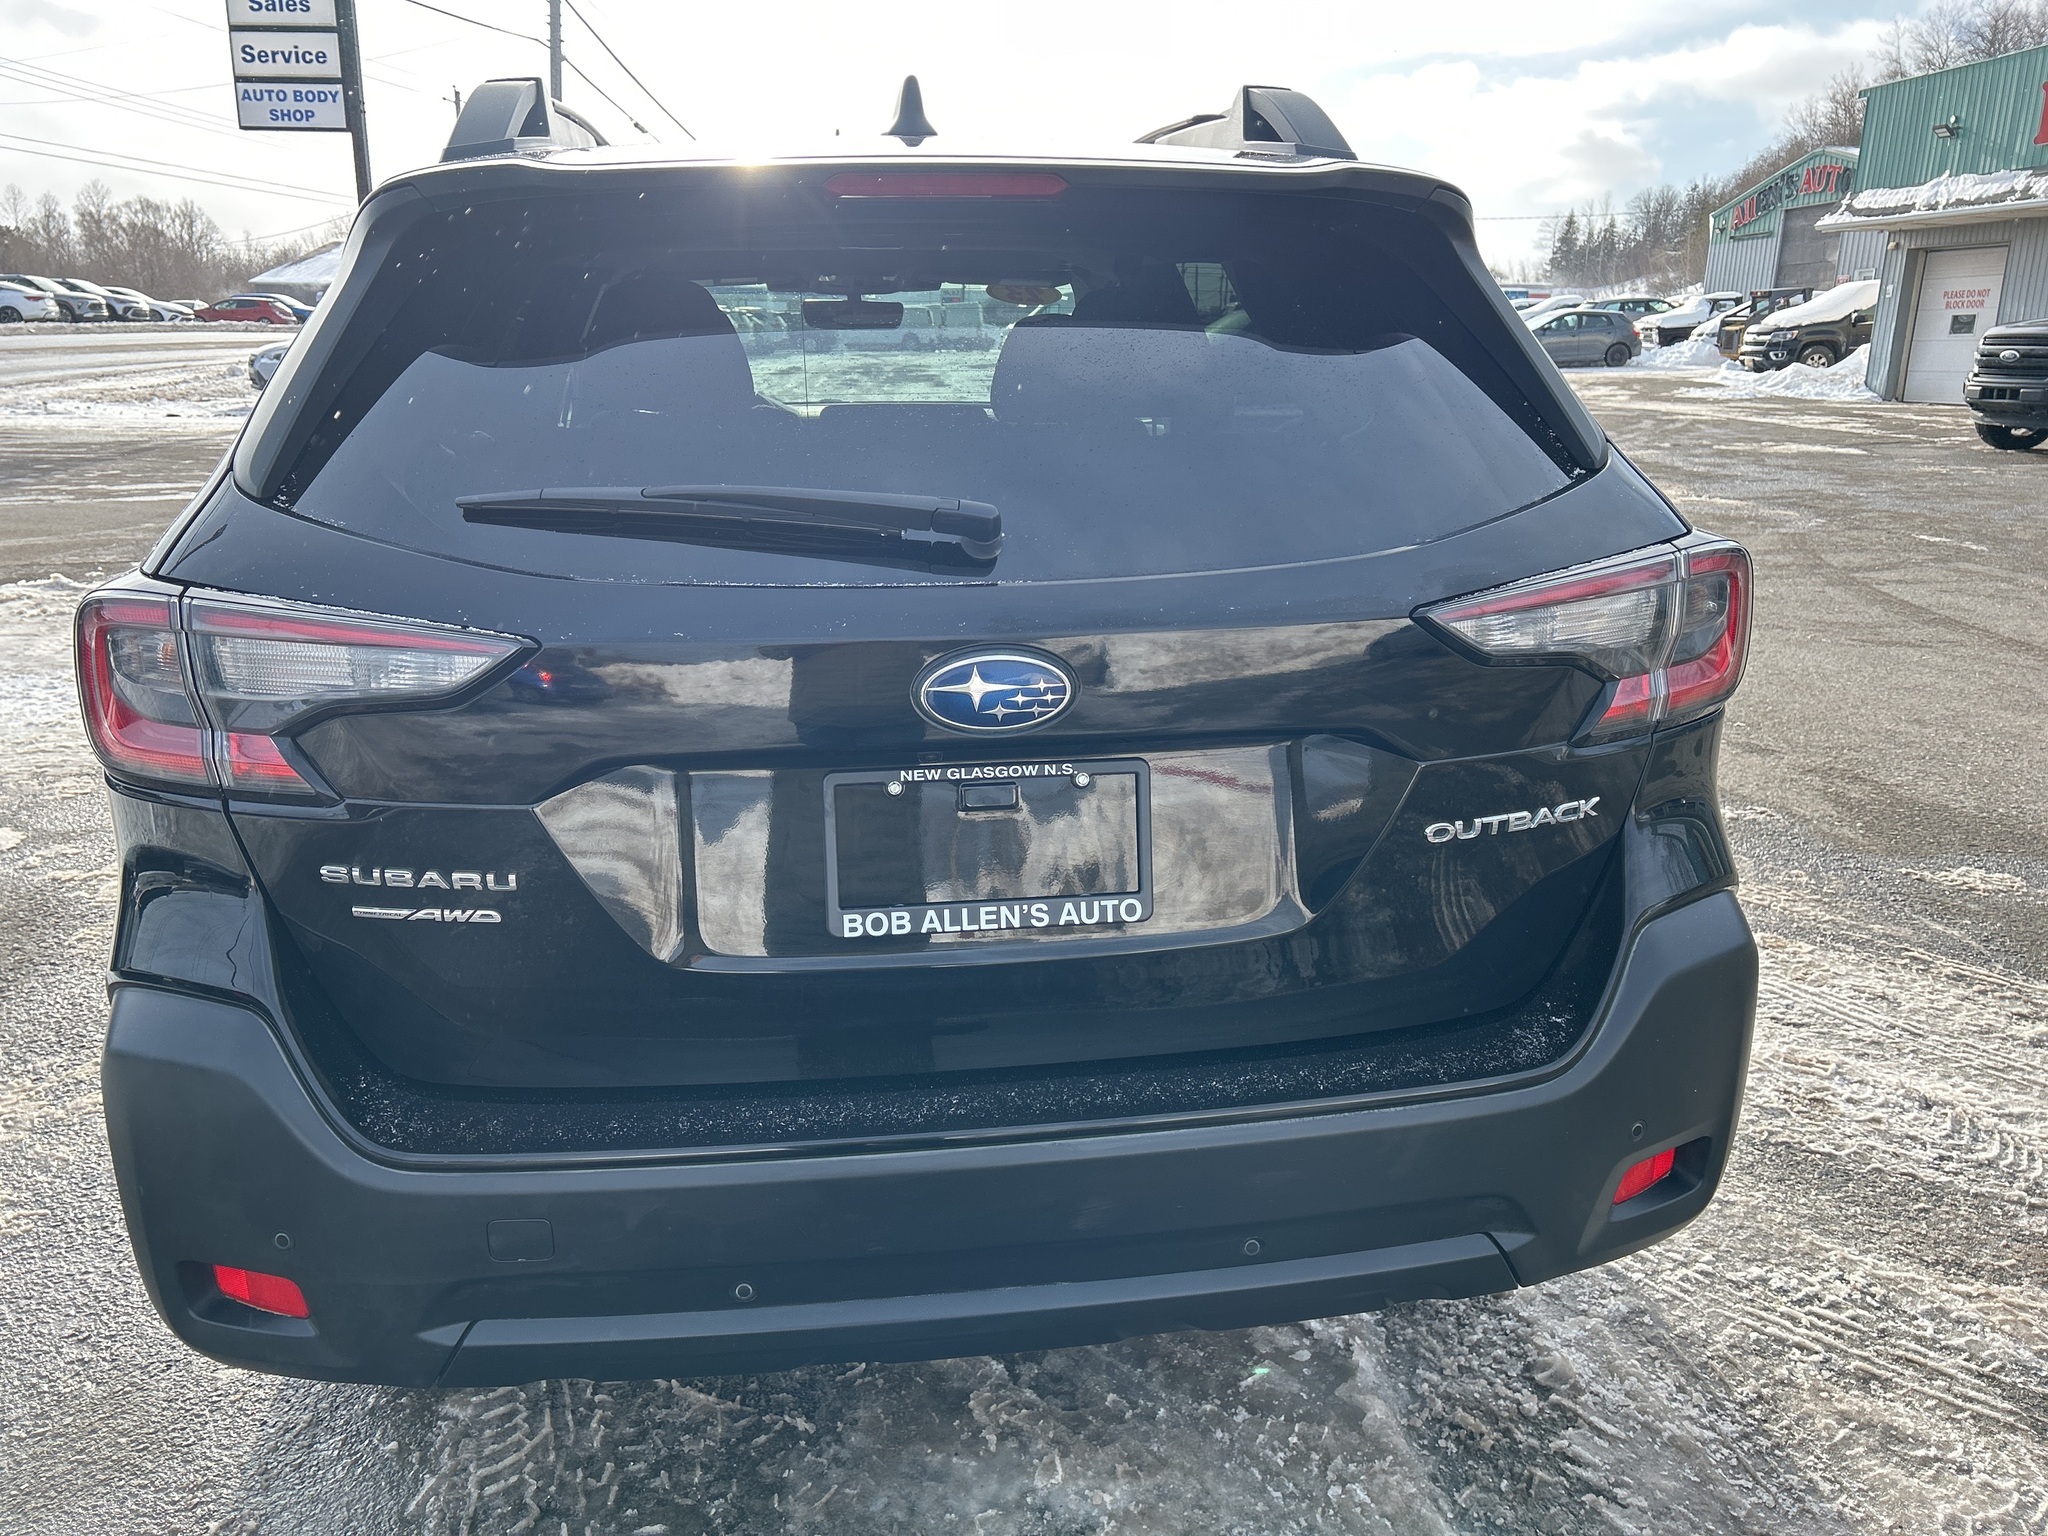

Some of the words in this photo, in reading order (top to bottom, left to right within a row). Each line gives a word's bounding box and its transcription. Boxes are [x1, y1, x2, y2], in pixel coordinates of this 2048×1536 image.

[248, 0, 311, 12] Sales
[240, 44, 327, 64] Service
[241, 89, 287, 102] AUTO
[293, 90, 339, 103] BODY
[269, 109, 315, 122] SHOP
[1798, 164, 1855, 194] AUTO
[1943, 290, 1966, 299] PLEASE
[1966, 289, 1976, 298] DO
[1977, 289, 1991, 298] NOT
[1945, 300, 1965, 309] BLOCK
[1966, 299, 1985, 308] DOOR
[900, 768, 941, 782] NEW
[946, 765, 1040, 780] GLASGOW
[1044, 763, 1078, 776] N.S.
[1424, 796, 1600, 843] OUTBACK
[319, 864, 518, 892] SUBARU
[406, 908, 502, 923] AWD
[842, 912, 912, 938] BOB
[920, 903, 1050, 934] ALLEN'S
[1058, 898, 1143, 926] AUTO
